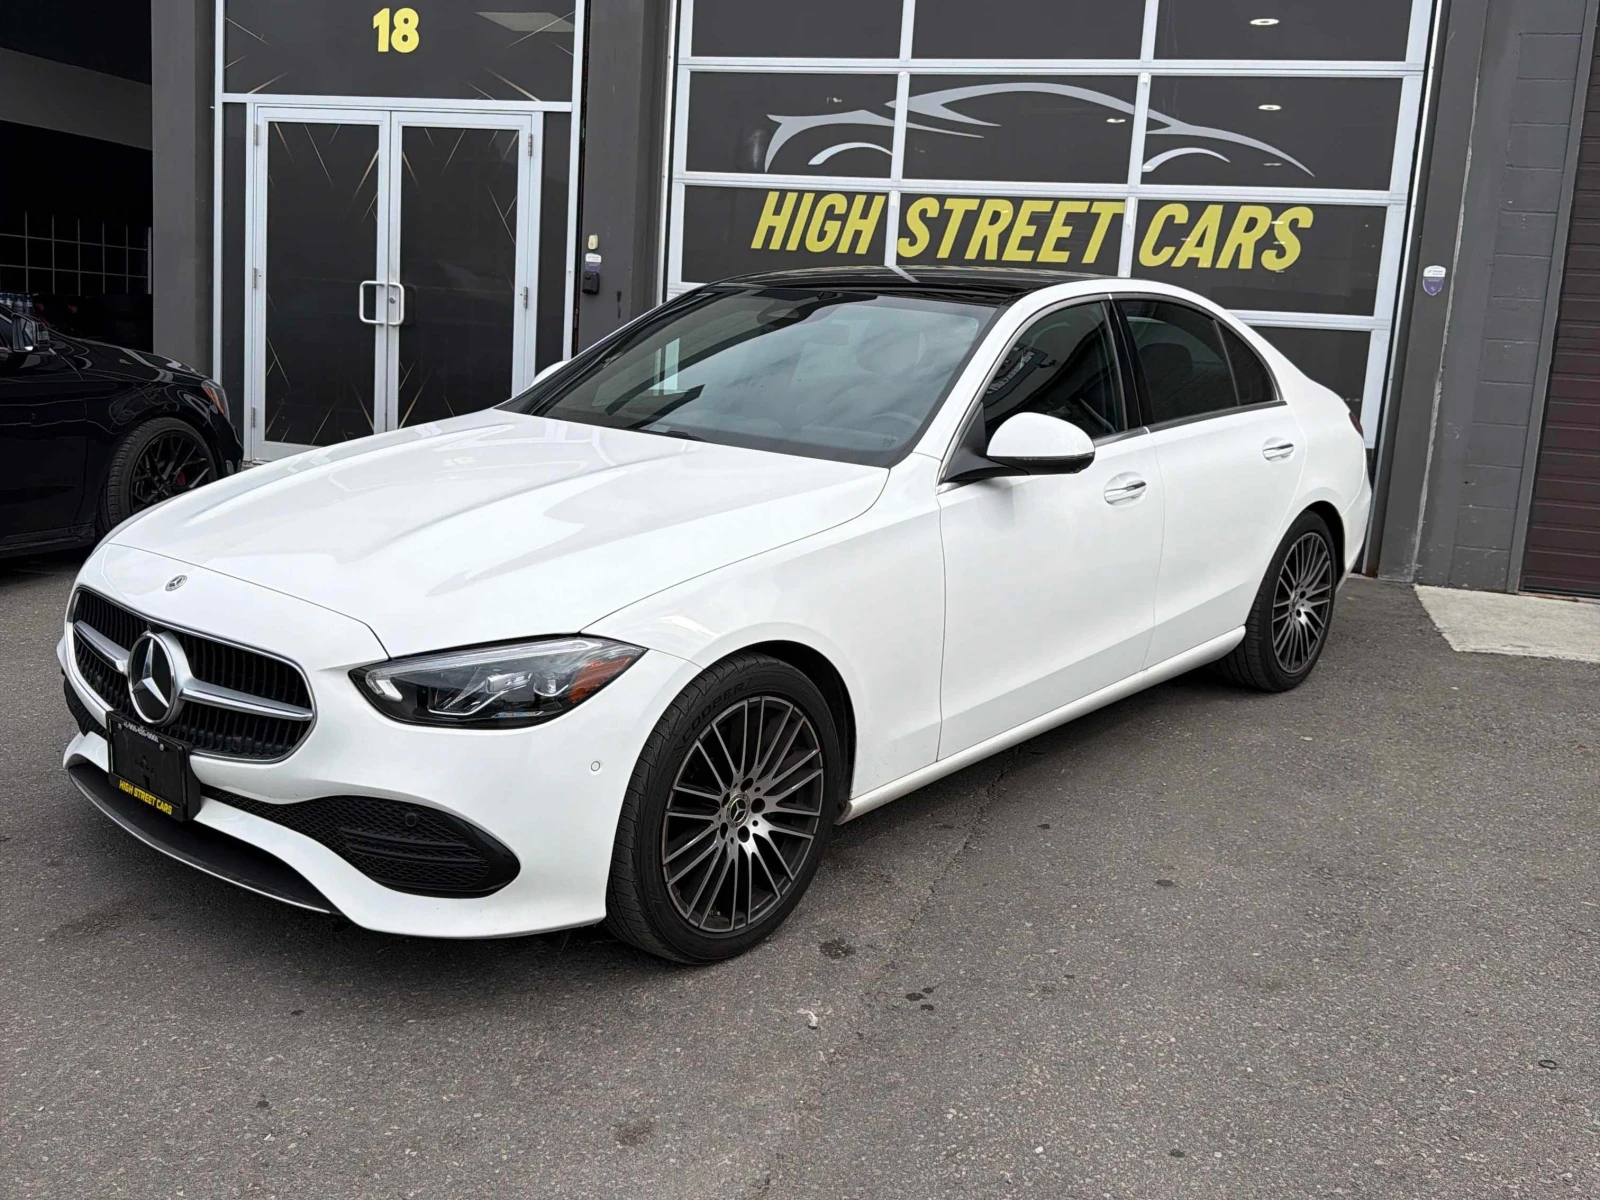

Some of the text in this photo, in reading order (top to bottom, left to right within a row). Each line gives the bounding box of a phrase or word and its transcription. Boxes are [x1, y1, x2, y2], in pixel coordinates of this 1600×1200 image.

[373, 7, 420, 53] 18
[750, 191, 1314, 271] HIGH STREET CARS
[681, 682, 745, 742] COOPER
[119, 779, 173, 815] HIGH STREET CARS
